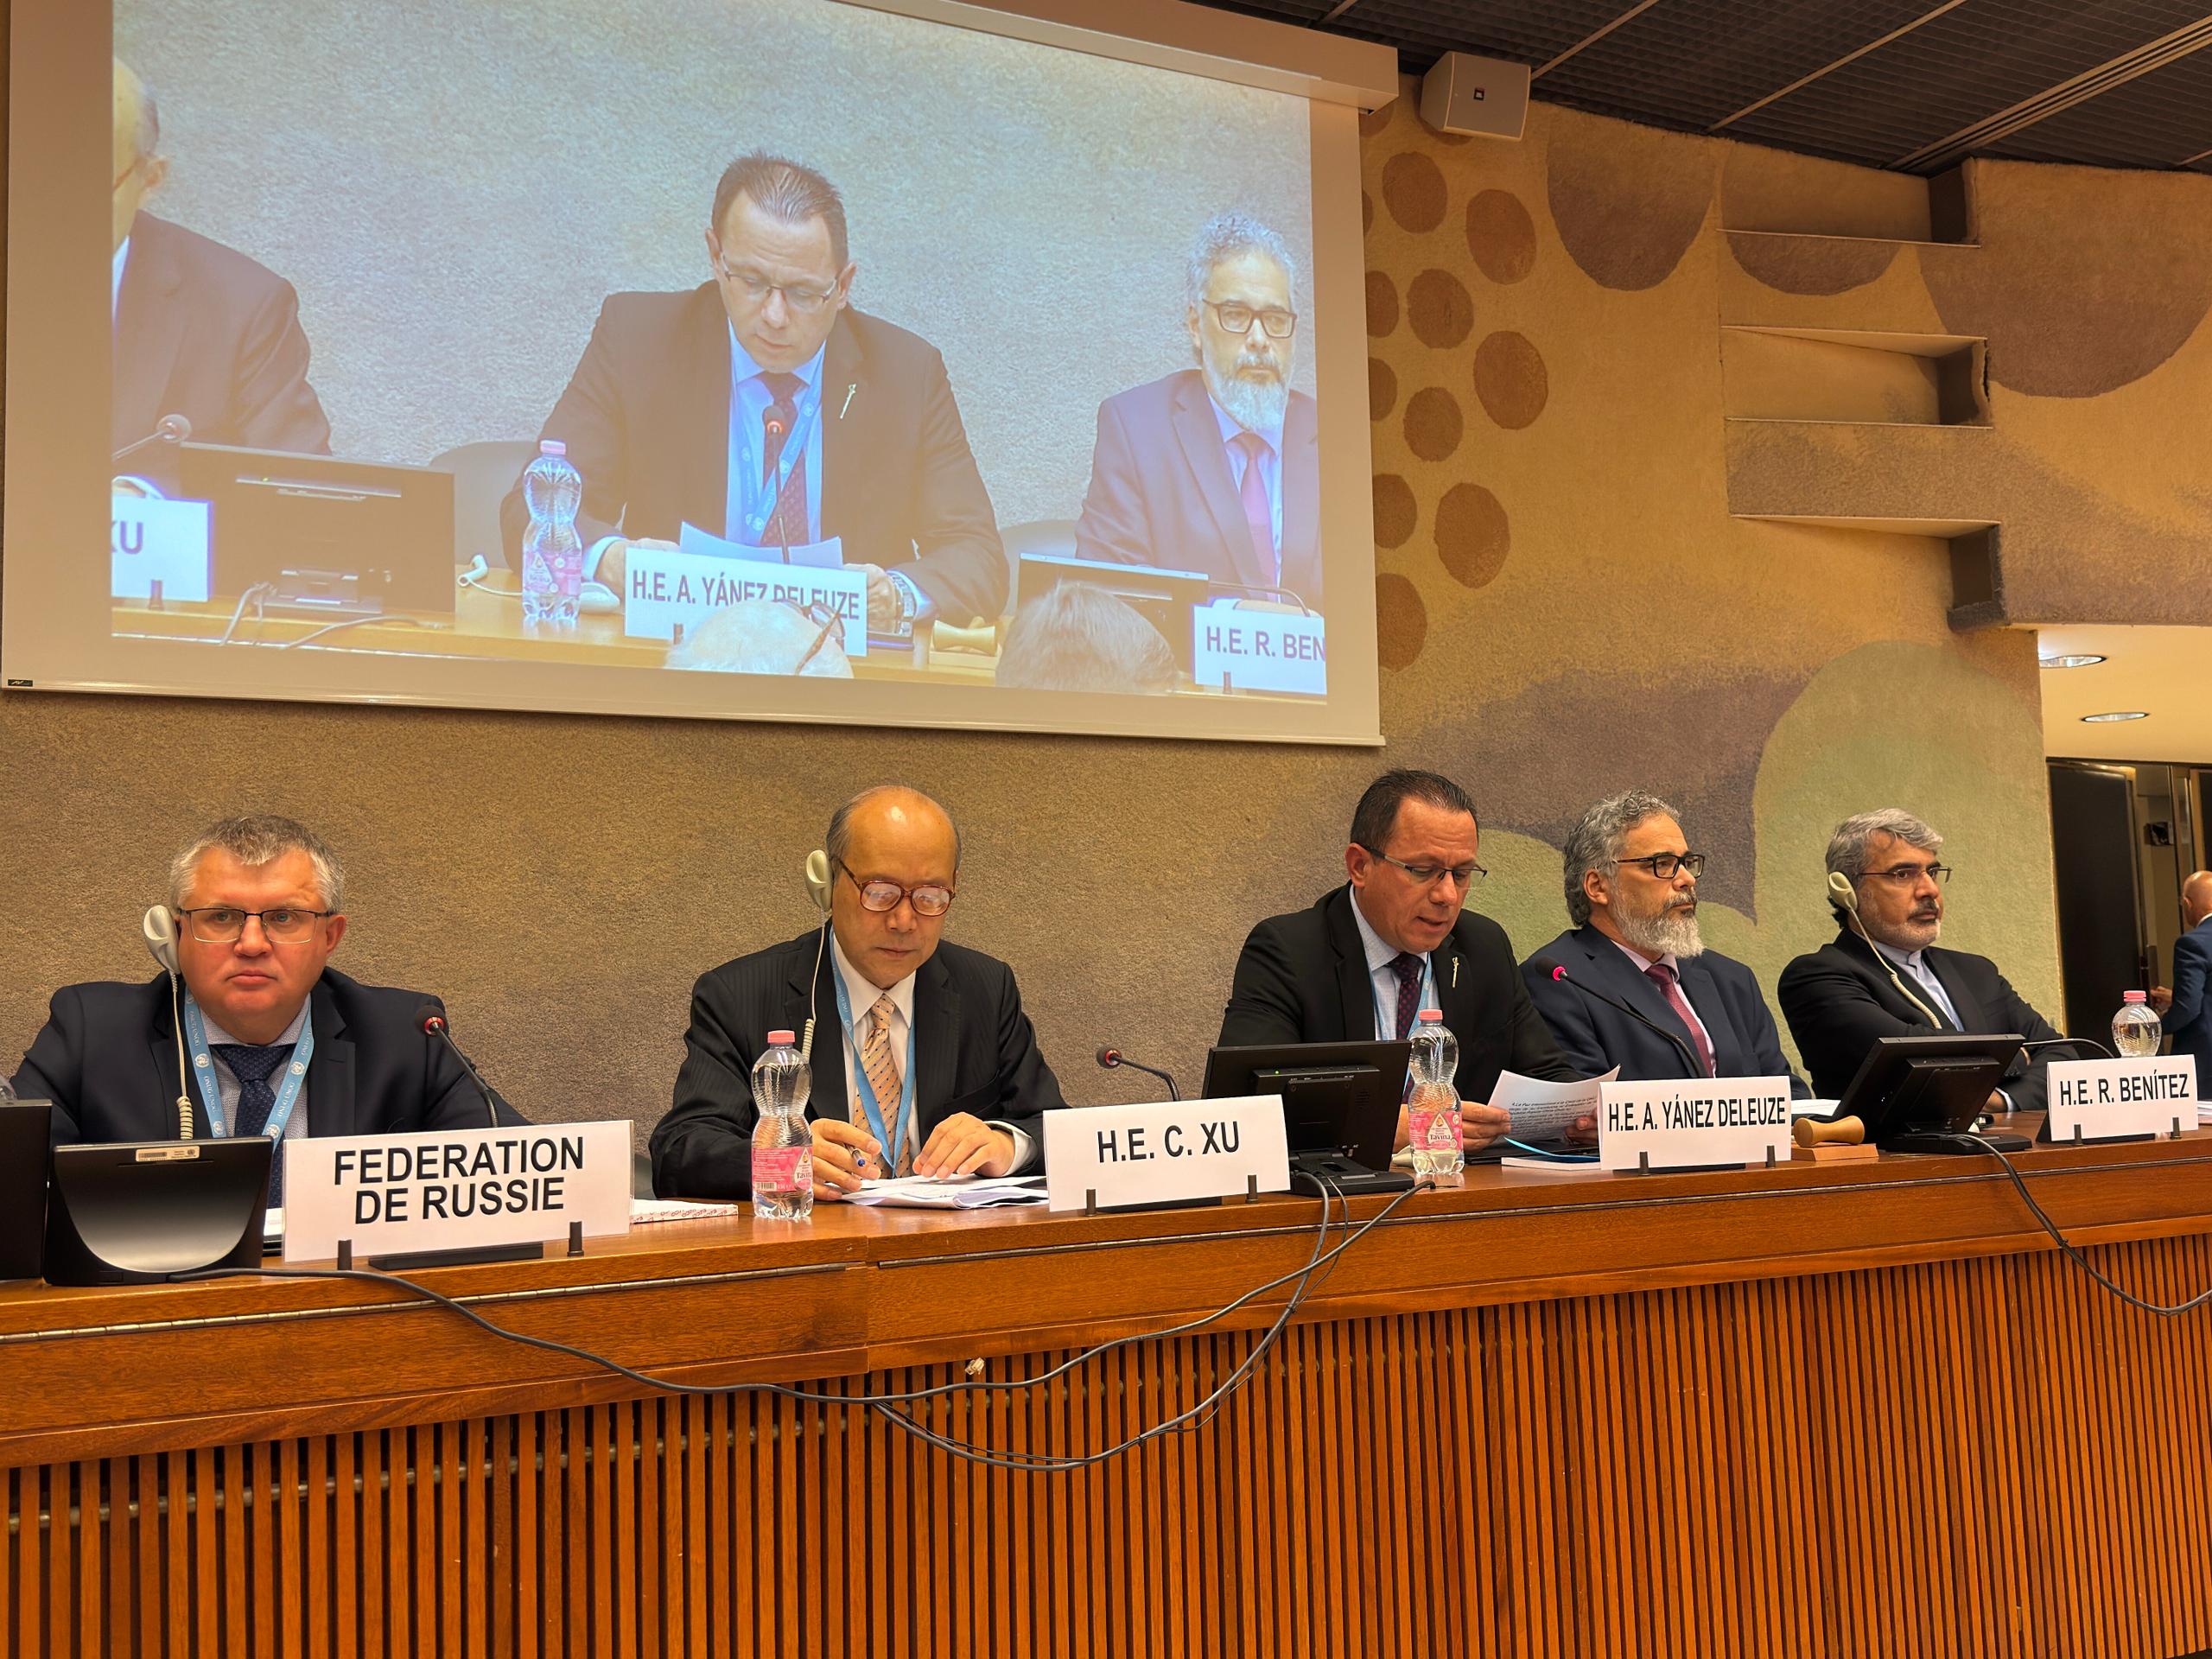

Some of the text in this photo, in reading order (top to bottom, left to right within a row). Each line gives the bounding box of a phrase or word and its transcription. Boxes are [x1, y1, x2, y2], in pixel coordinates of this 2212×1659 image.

[632, 569, 671, 602] H.E.
[677, 575, 696, 605] A.
[1206, 626, 1325, 661] H.E. R. BEN
[2059, 1069, 2190, 1106] H.E. R. BENÍTEZ
[1609, 1103, 1638, 1132] H.E.
[1643, 1102, 1657, 1130] A.
[1662, 1093, 1713, 1129] YÁNEZ
[1718, 1096, 1786, 1127] DELEUZE
[334, 1136, 583, 1185] FEDERATION
[1097, 1121, 1239, 1163] H.E. C. XU
[355, 1177, 564, 1224] DE RUSSIE
